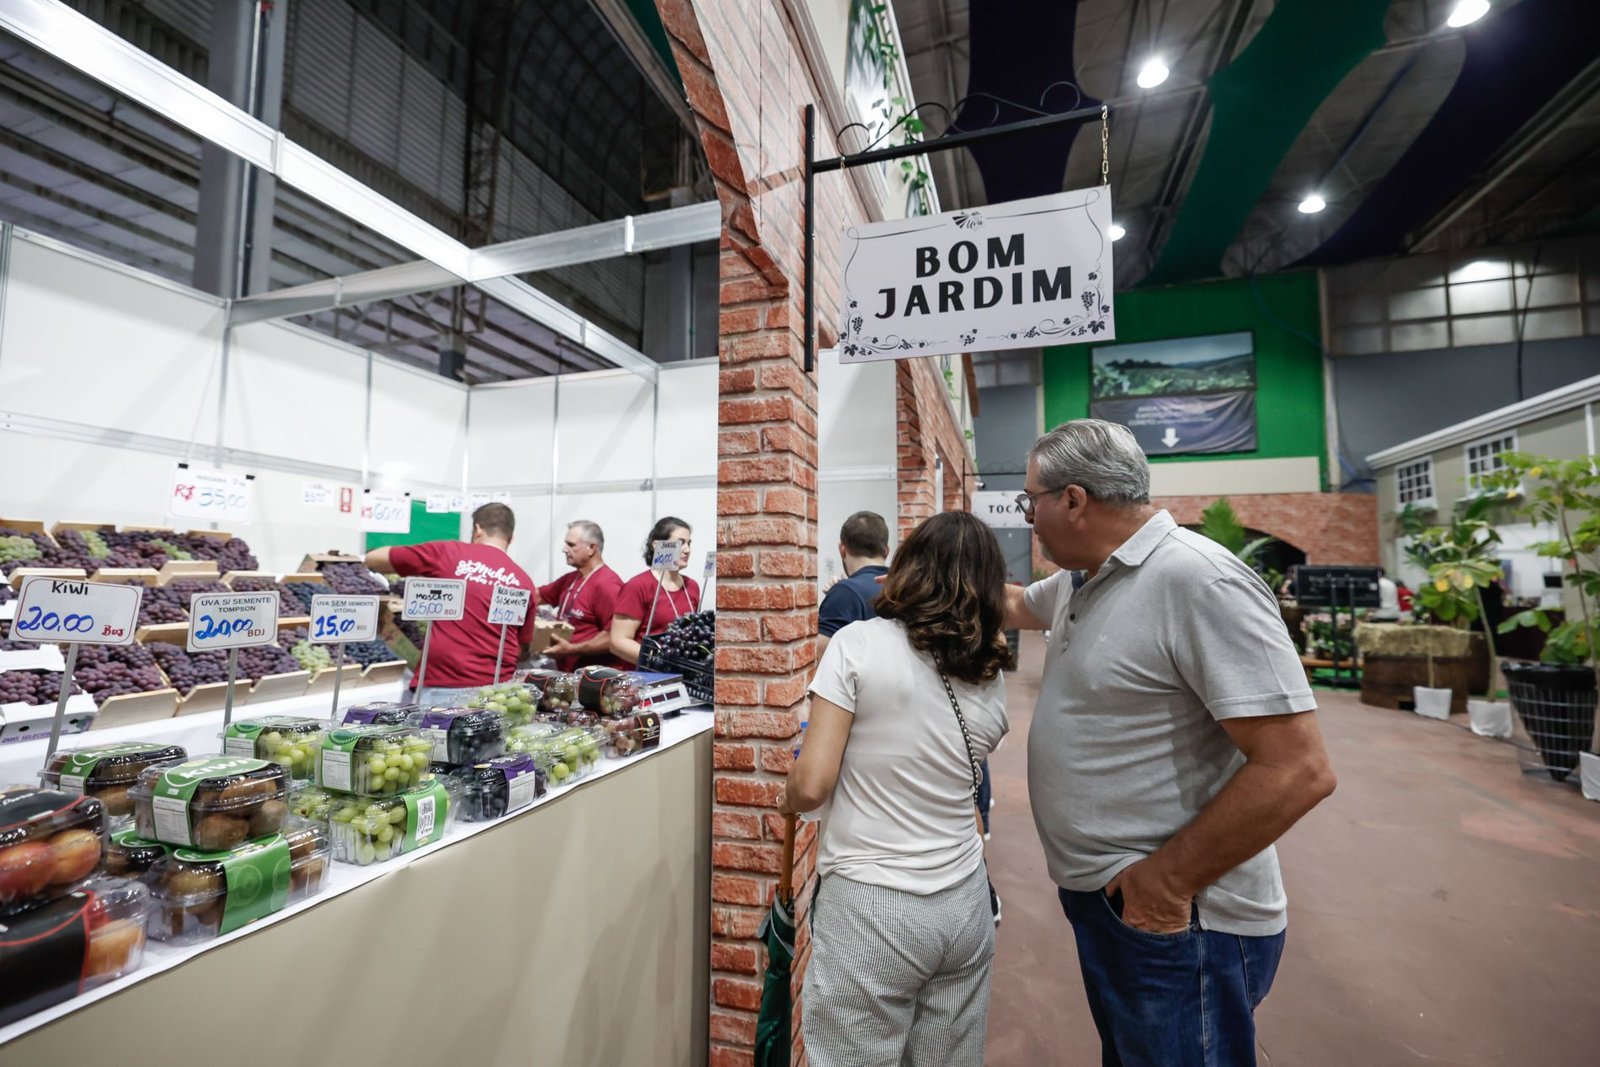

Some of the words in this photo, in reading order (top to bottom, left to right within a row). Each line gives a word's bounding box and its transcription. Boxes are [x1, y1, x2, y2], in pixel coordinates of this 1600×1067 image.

[916, 233, 1025, 279] BOM
[875, 265, 1072, 319] JARDIM
[232, 597, 271, 605] SEMENTE
[408, 600, 443, 616] 25,00
[416, 593, 453, 602] MOSCATO
[17, 606, 95, 633] 20,00
[195, 614, 253, 640] 20,00
[247, 628, 265, 637] BDJ
[315, 614, 355, 638] 15,00
